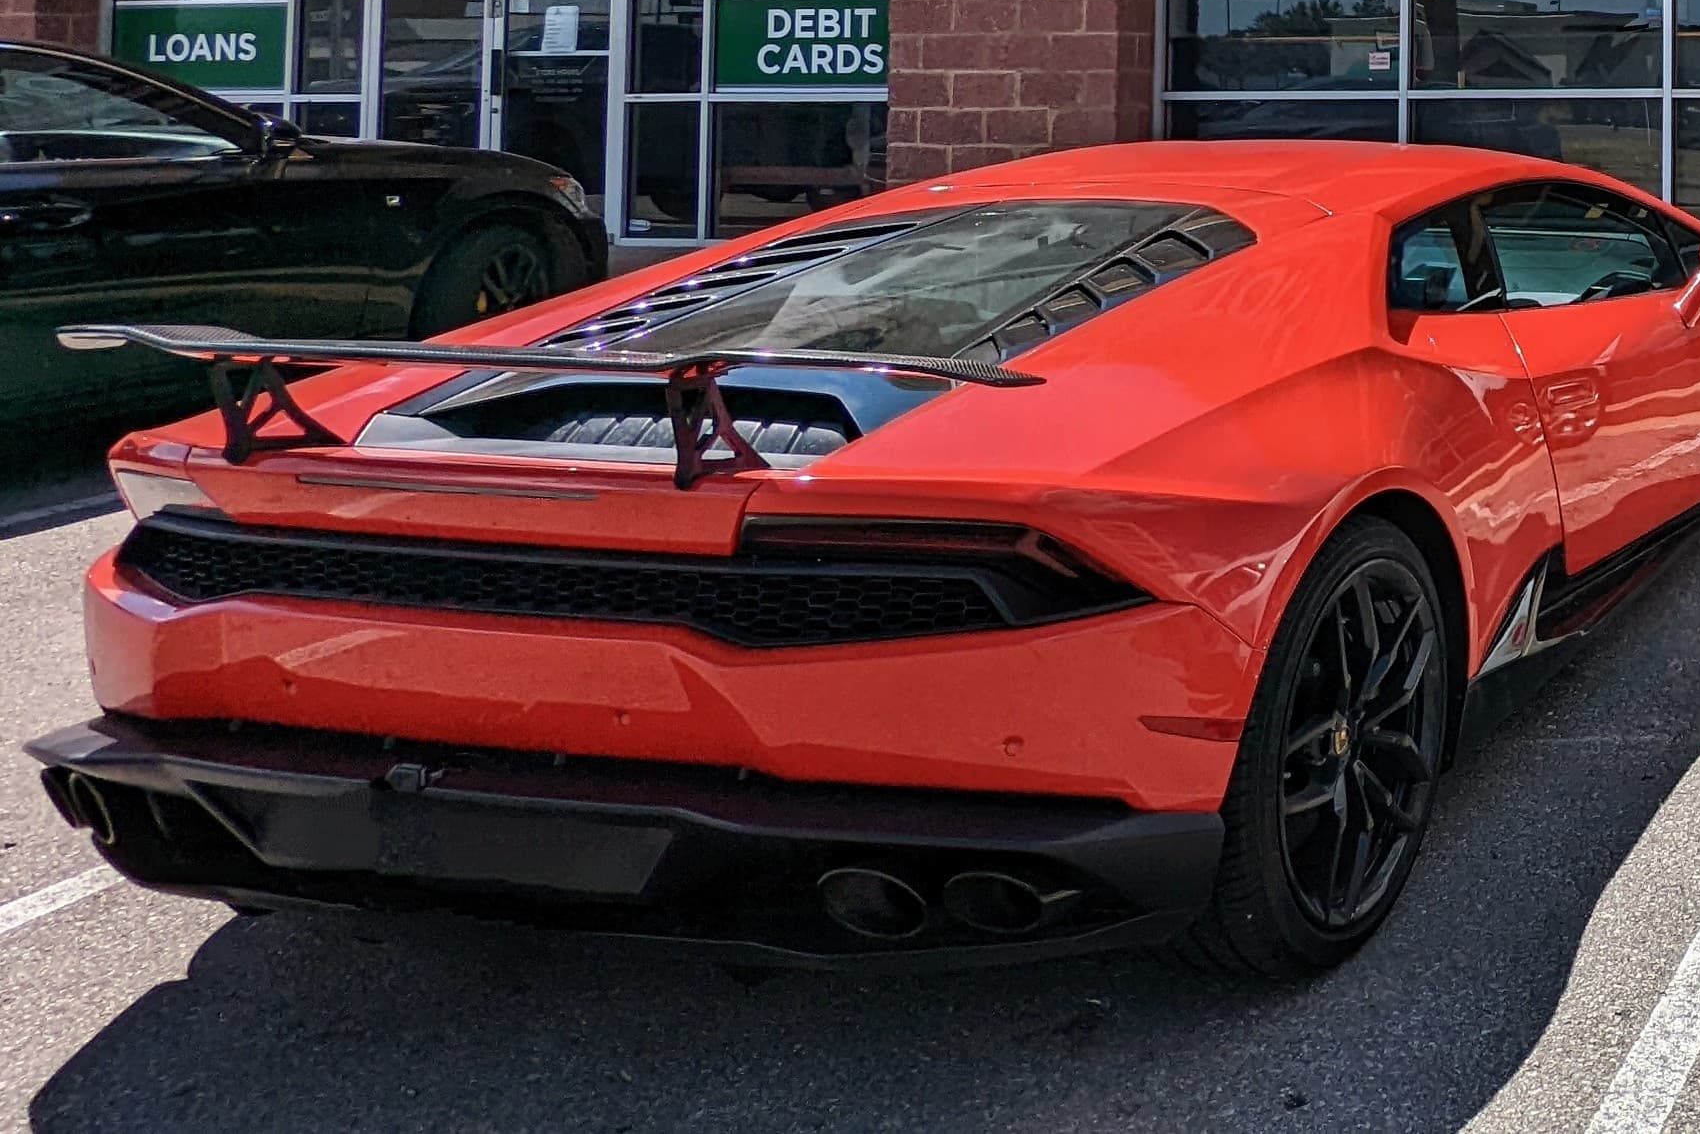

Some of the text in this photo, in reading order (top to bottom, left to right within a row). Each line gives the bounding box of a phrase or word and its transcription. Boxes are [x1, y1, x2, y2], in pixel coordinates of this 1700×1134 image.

[767, 8, 877, 40] DEBIT
[147, 32, 258, 63] LOANS
[757, 43, 885, 75] CARDS
